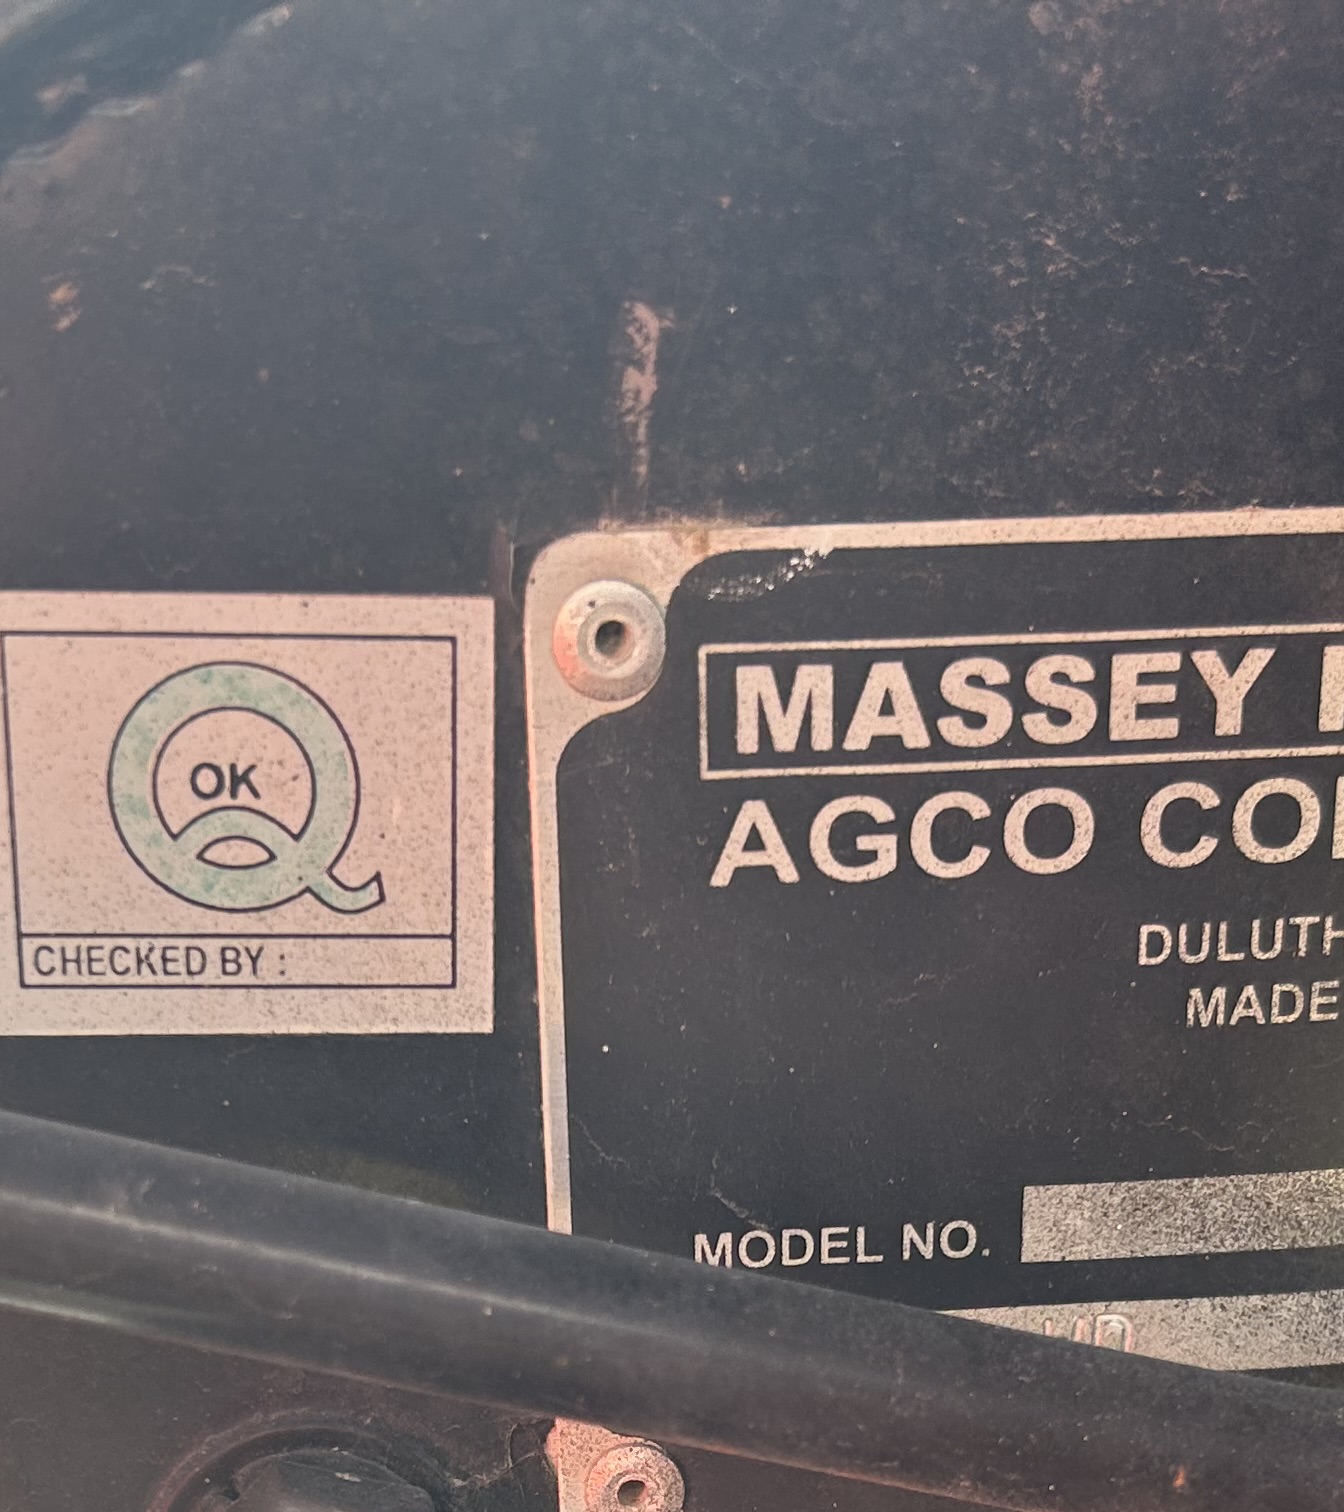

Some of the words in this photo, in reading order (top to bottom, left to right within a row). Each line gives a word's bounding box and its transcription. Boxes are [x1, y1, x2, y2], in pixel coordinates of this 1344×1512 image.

[736, 646, 1275, 755] MASSEY
[189, 763, 261, 800] OK
[709, 787, 1096, 887] AGCO
[33, 945, 207, 977] CHECKED
[1185, 979, 1341, 1029] MADE
[692, 1226, 884, 1270] MODEL
[901, 1219, 991, 1263] NO.
